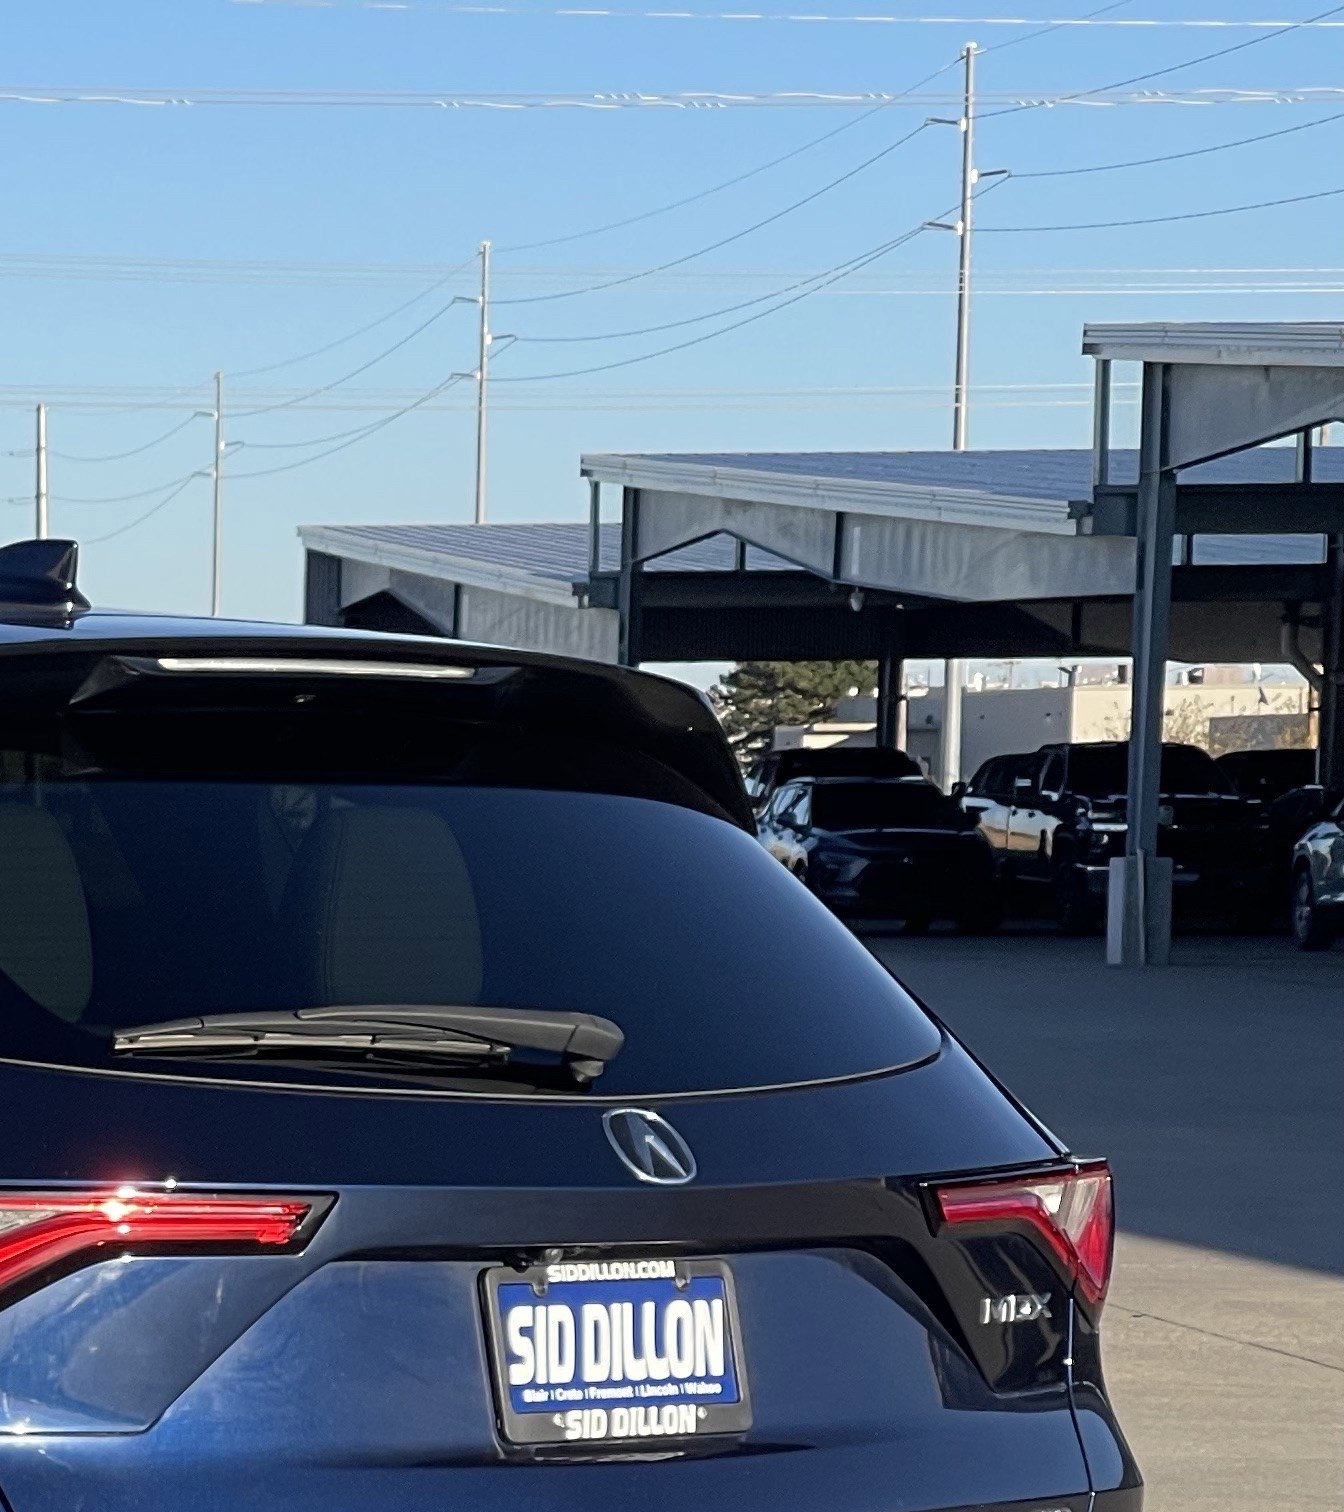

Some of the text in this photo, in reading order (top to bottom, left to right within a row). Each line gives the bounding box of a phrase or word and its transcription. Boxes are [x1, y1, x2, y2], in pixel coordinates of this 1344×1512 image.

[546, 1261, 676, 1283] SIDDILLON.COM
[980, 1293, 1052, 1324] MDX
[507, 1299, 724, 1386] SID DILLON
[565, 1404, 697, 1440] SID DILLON
